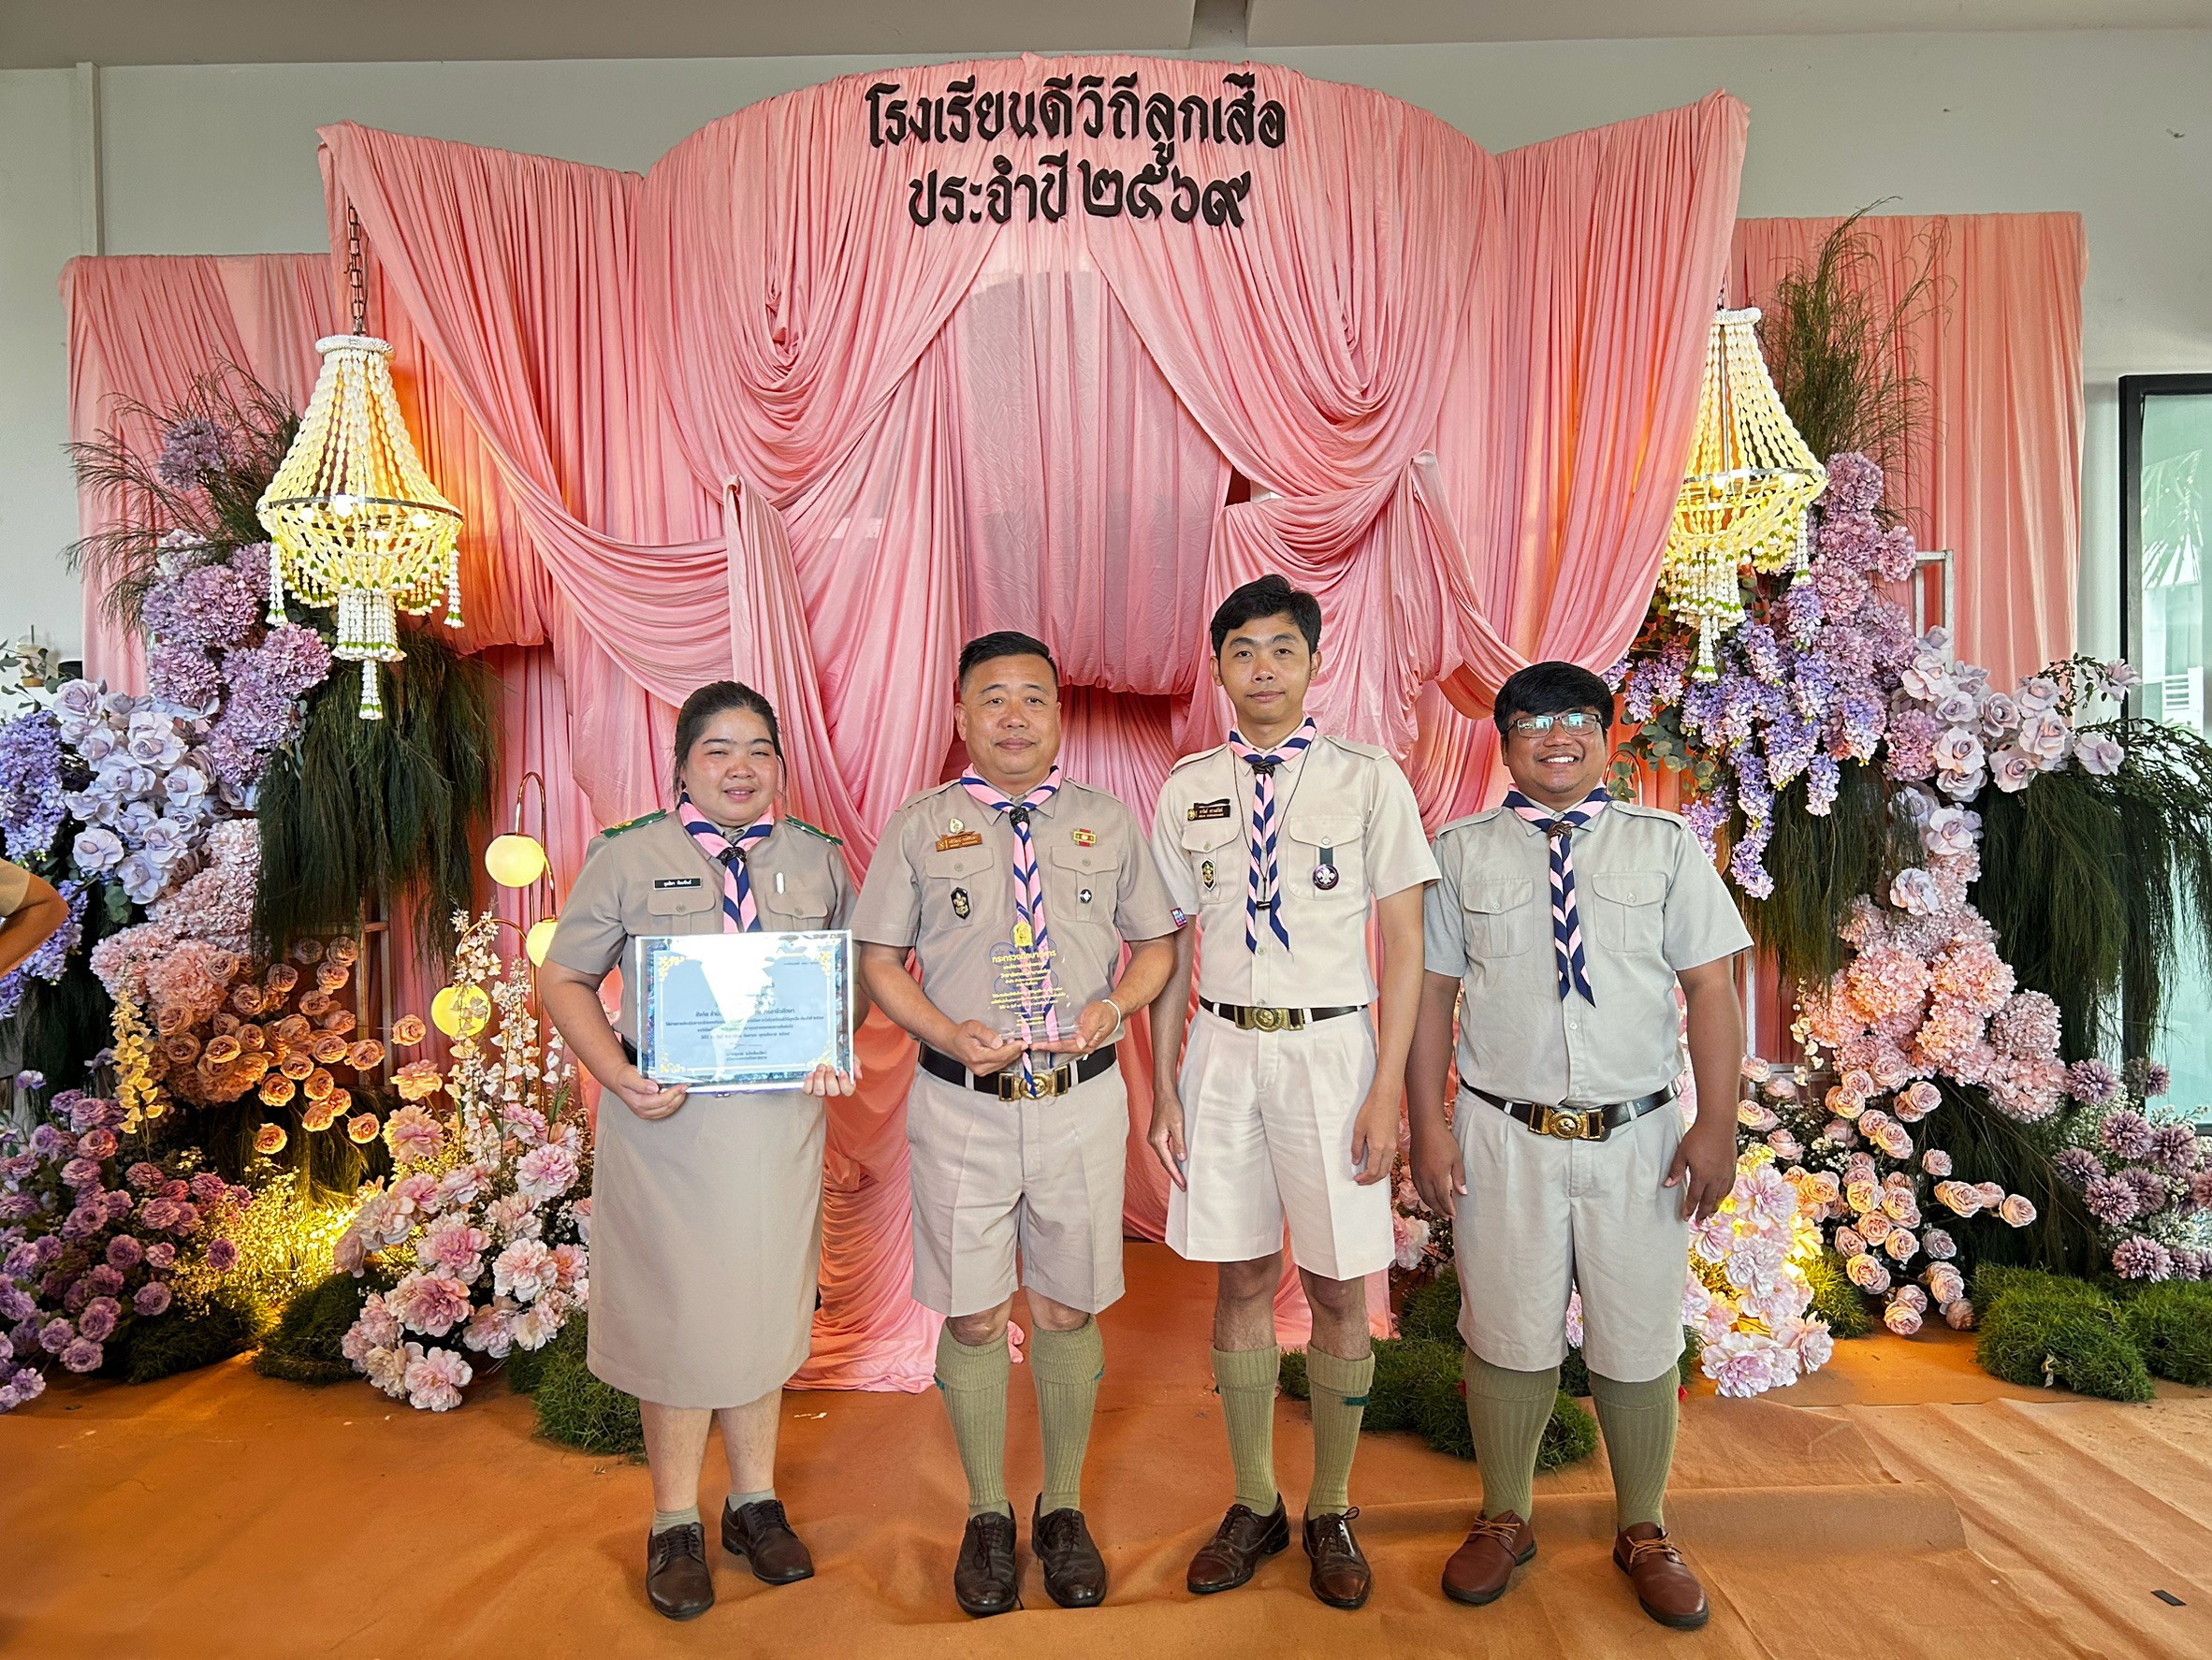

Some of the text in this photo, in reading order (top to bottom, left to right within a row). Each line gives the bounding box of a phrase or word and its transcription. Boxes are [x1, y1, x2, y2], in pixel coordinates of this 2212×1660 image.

[865, 71, 1286, 166] โรงเรียนดีวิถีลูกเสือ
[909, 150, 1251, 230] ประจำปี ๒๕๖๙
